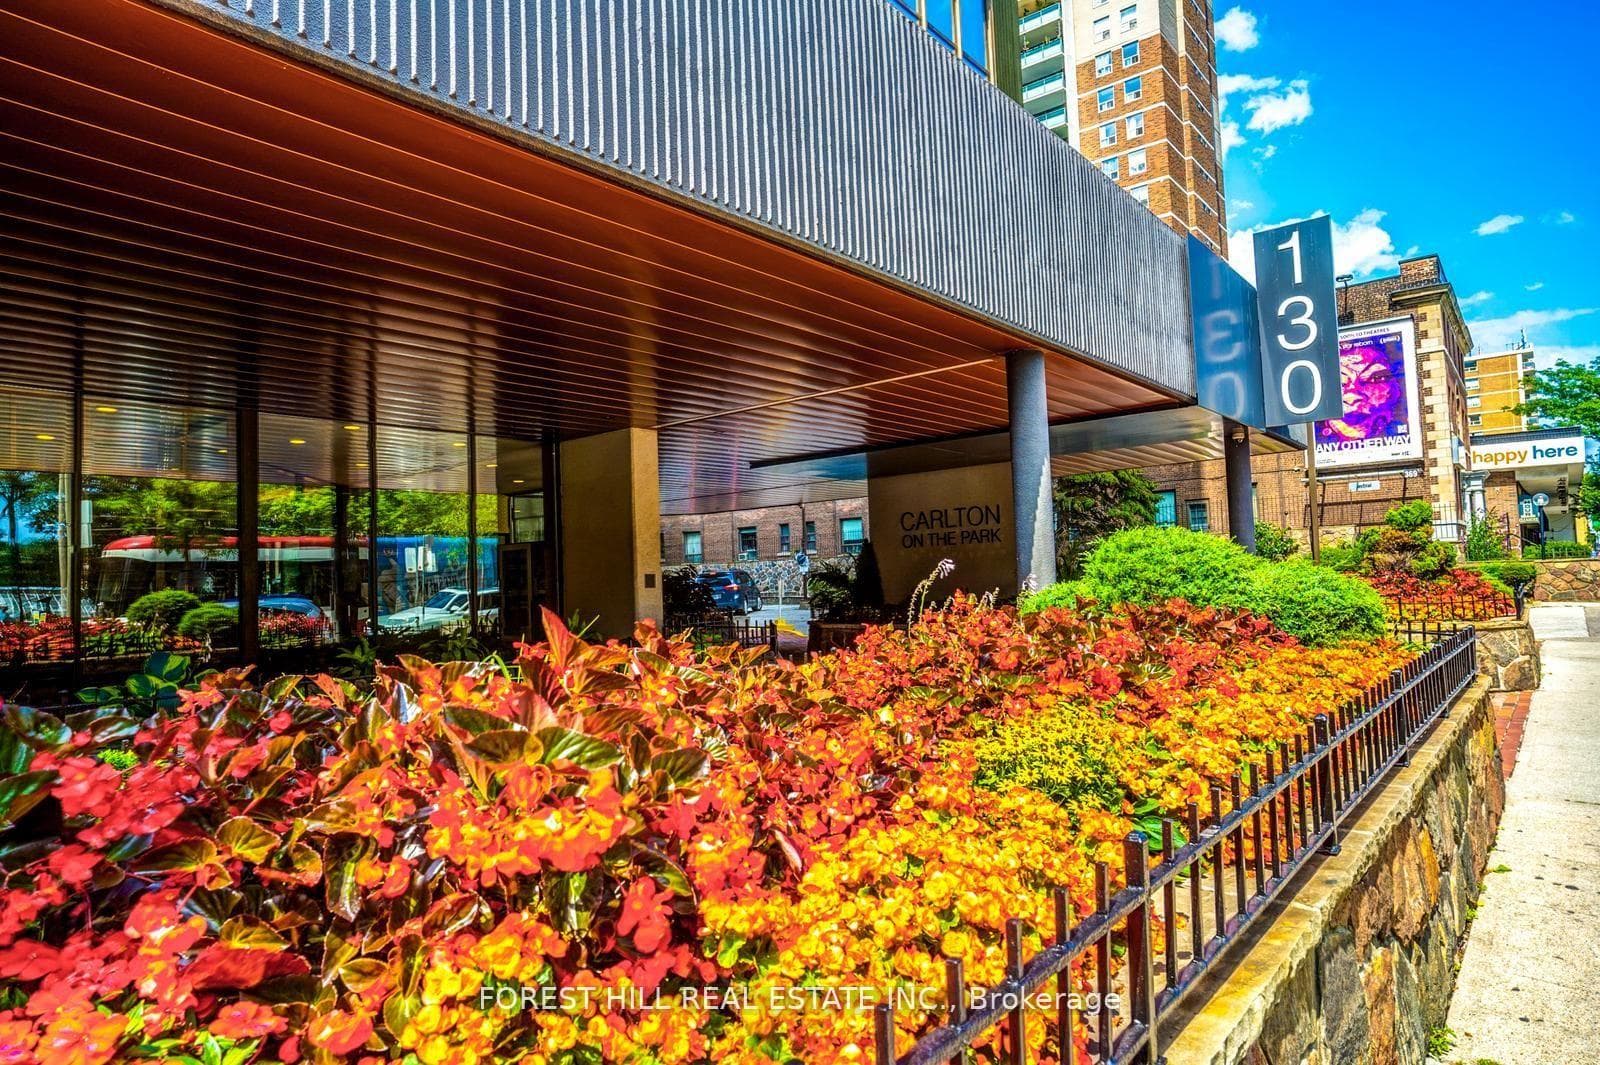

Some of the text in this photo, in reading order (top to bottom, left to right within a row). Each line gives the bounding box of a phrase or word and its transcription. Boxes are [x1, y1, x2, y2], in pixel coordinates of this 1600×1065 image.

[1277, 230, 1322, 415] 130
[1316, 434, 1411, 453] ANY OTHER WAY
[1472, 445, 1578, 466] happy here
[900, 504, 1001, 532] CARLTON
[902, 528, 1002, 549] ON THE PARK
